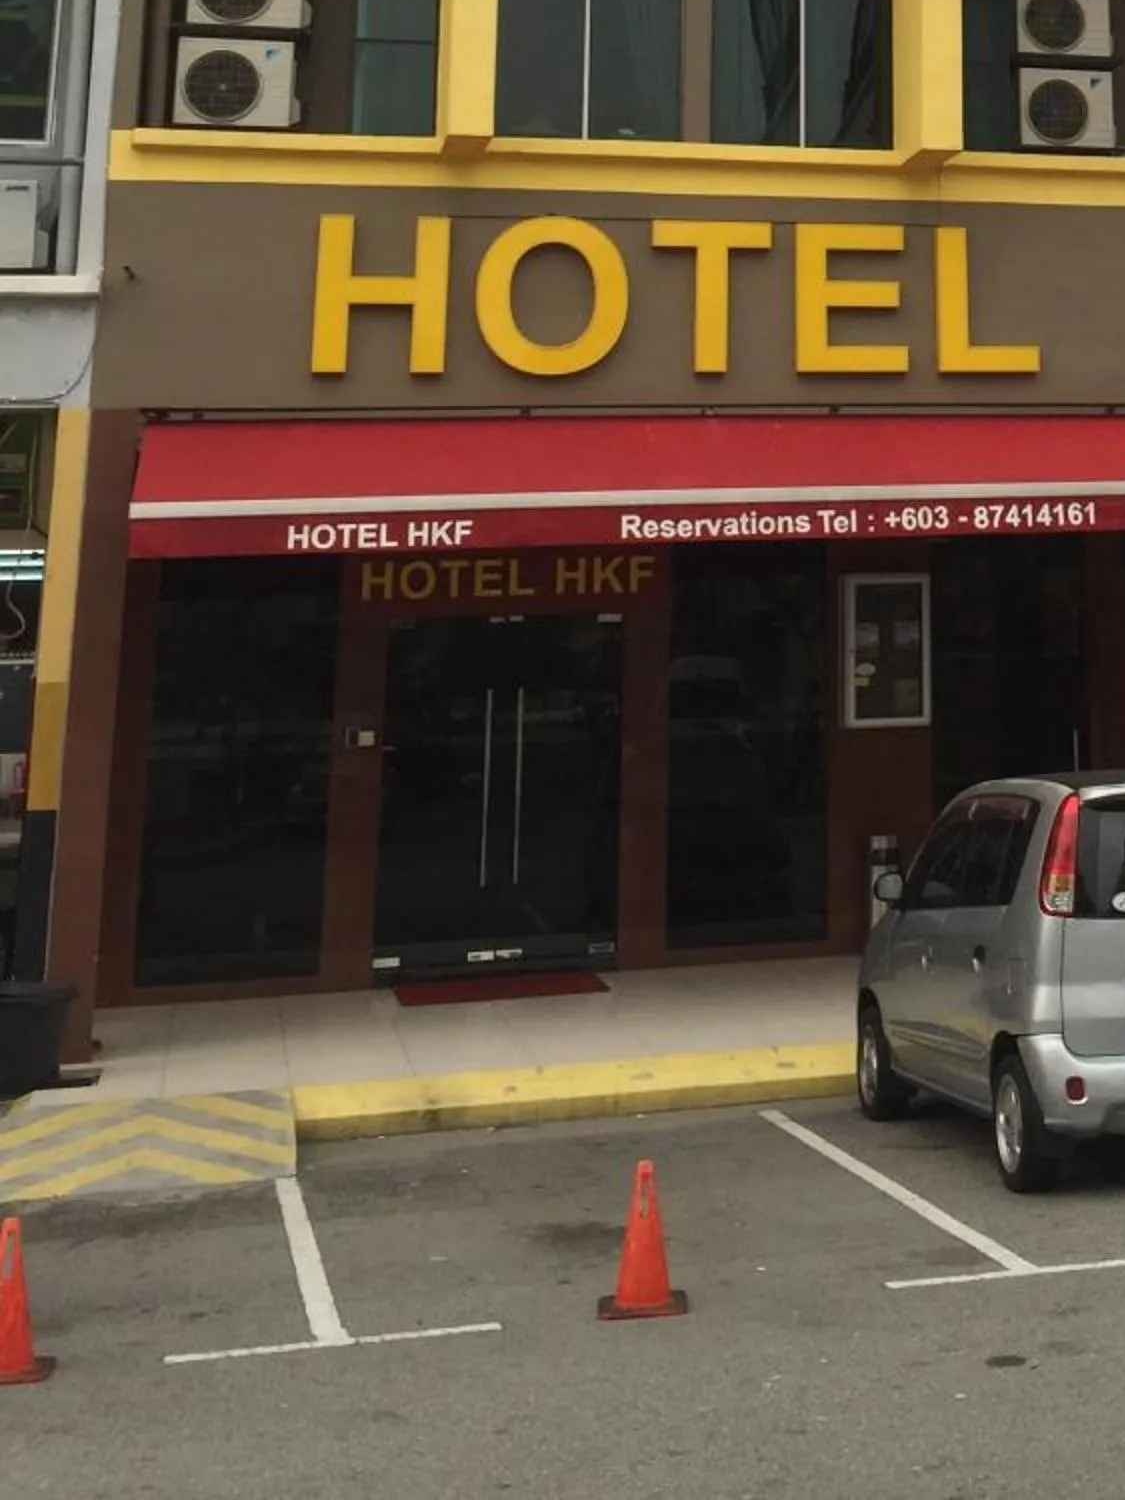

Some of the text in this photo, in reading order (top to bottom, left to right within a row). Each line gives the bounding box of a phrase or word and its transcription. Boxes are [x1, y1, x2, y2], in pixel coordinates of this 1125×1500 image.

[309, 213, 1041, 378] HOTEL
[286, 519, 473, 550] HOTEL HKF
[619, 511, 810, 540] Reservations
[816, 508, 858, 534] Tel
[884, 505, 949, 531] +603
[973, 502, 1096, 529] 87414161
[360, 556, 656, 601] HOTEL HKF
